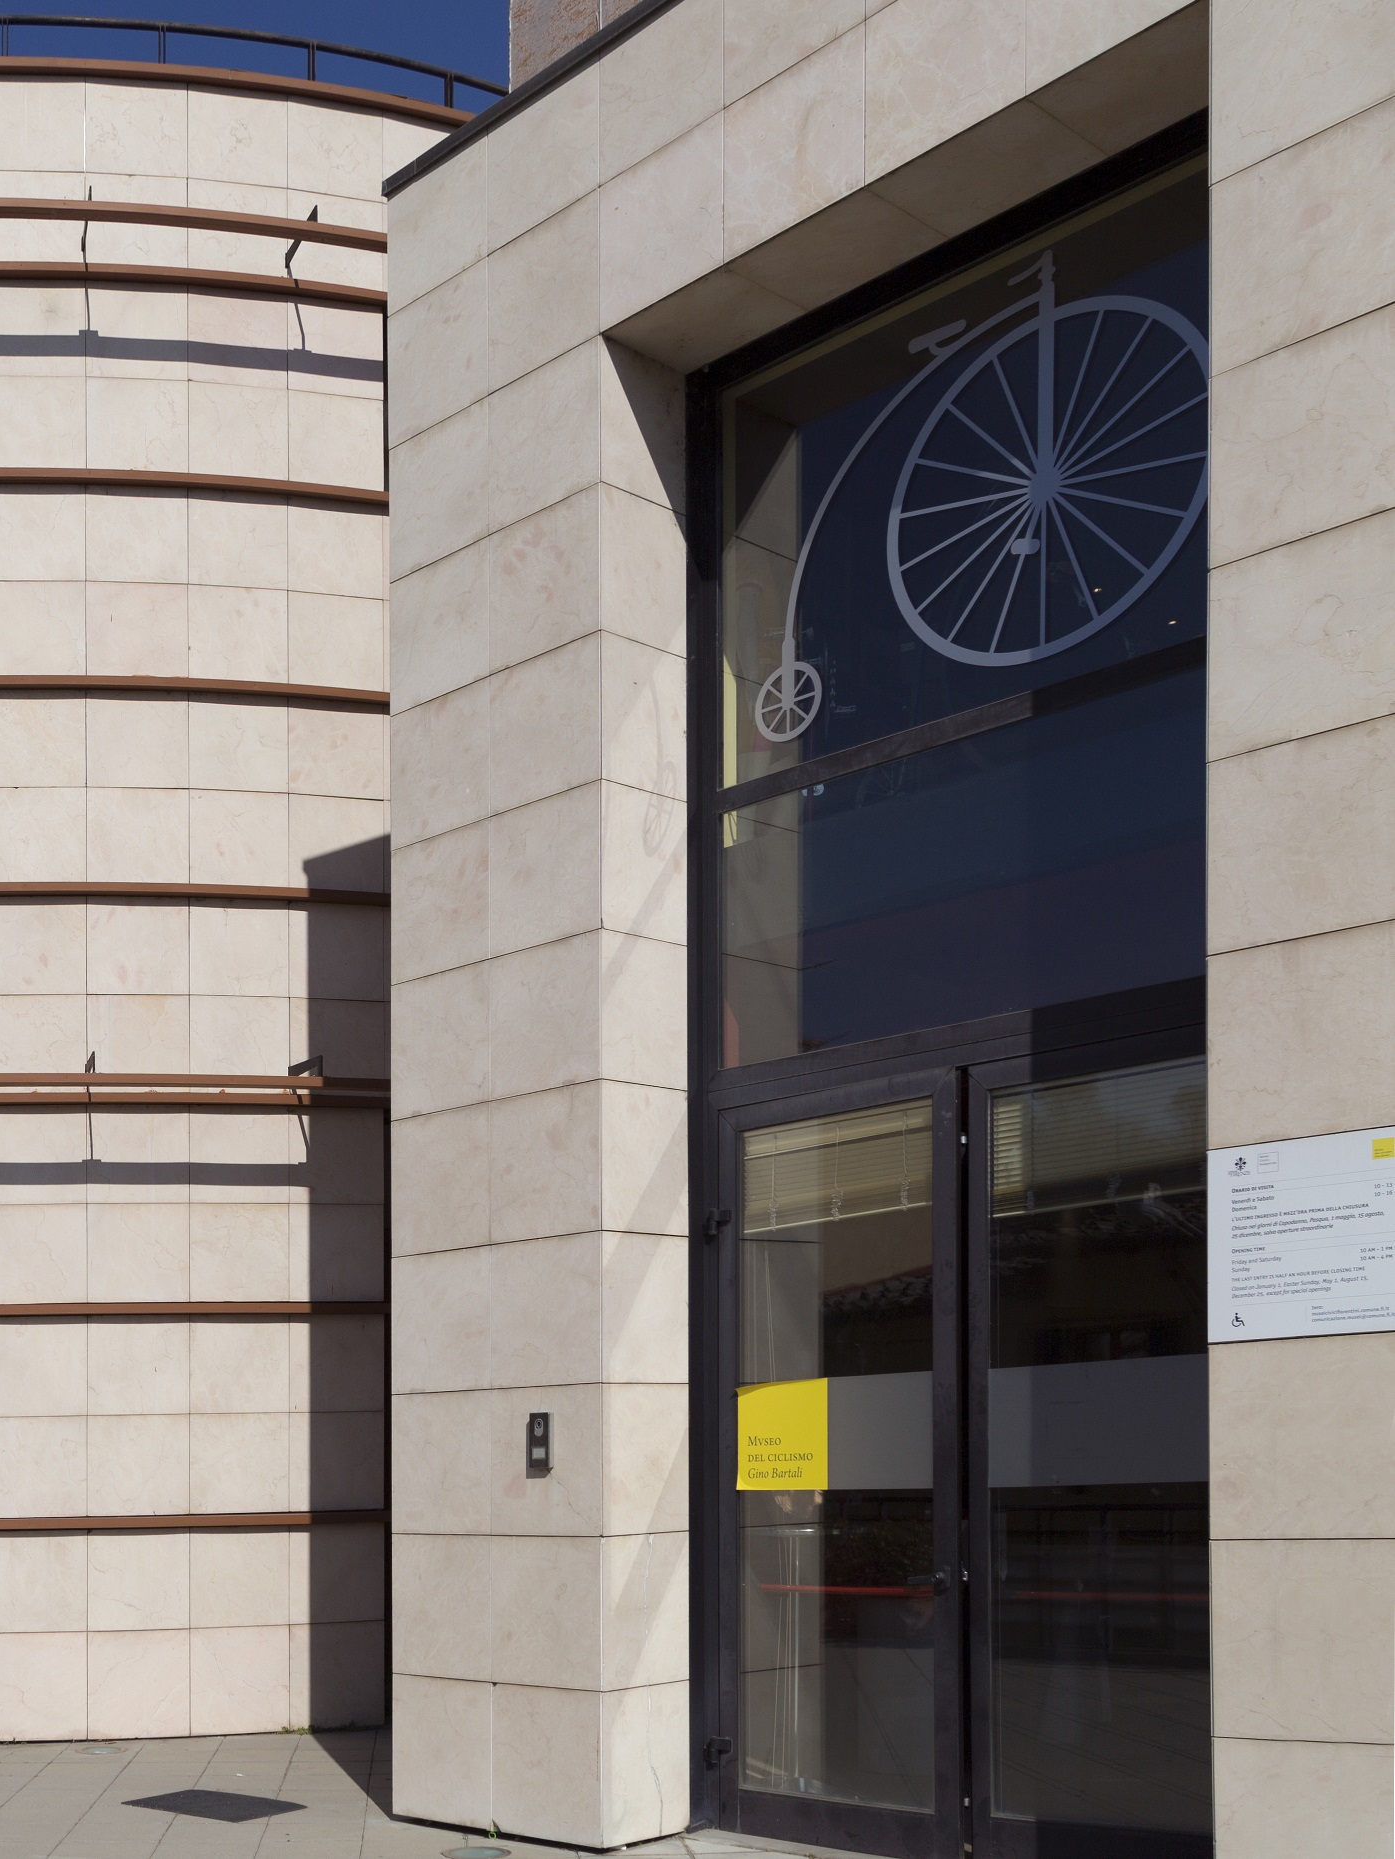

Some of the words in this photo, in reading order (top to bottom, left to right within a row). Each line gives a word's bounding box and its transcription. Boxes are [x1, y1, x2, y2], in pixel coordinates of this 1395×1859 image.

[748, 1454, 765, 1462] DEL
[768, 1453, 813, 1461] CICLISMO
[748, 1468, 769, 1479] Gino
[771, 1467, 803, 1479] Bartali
